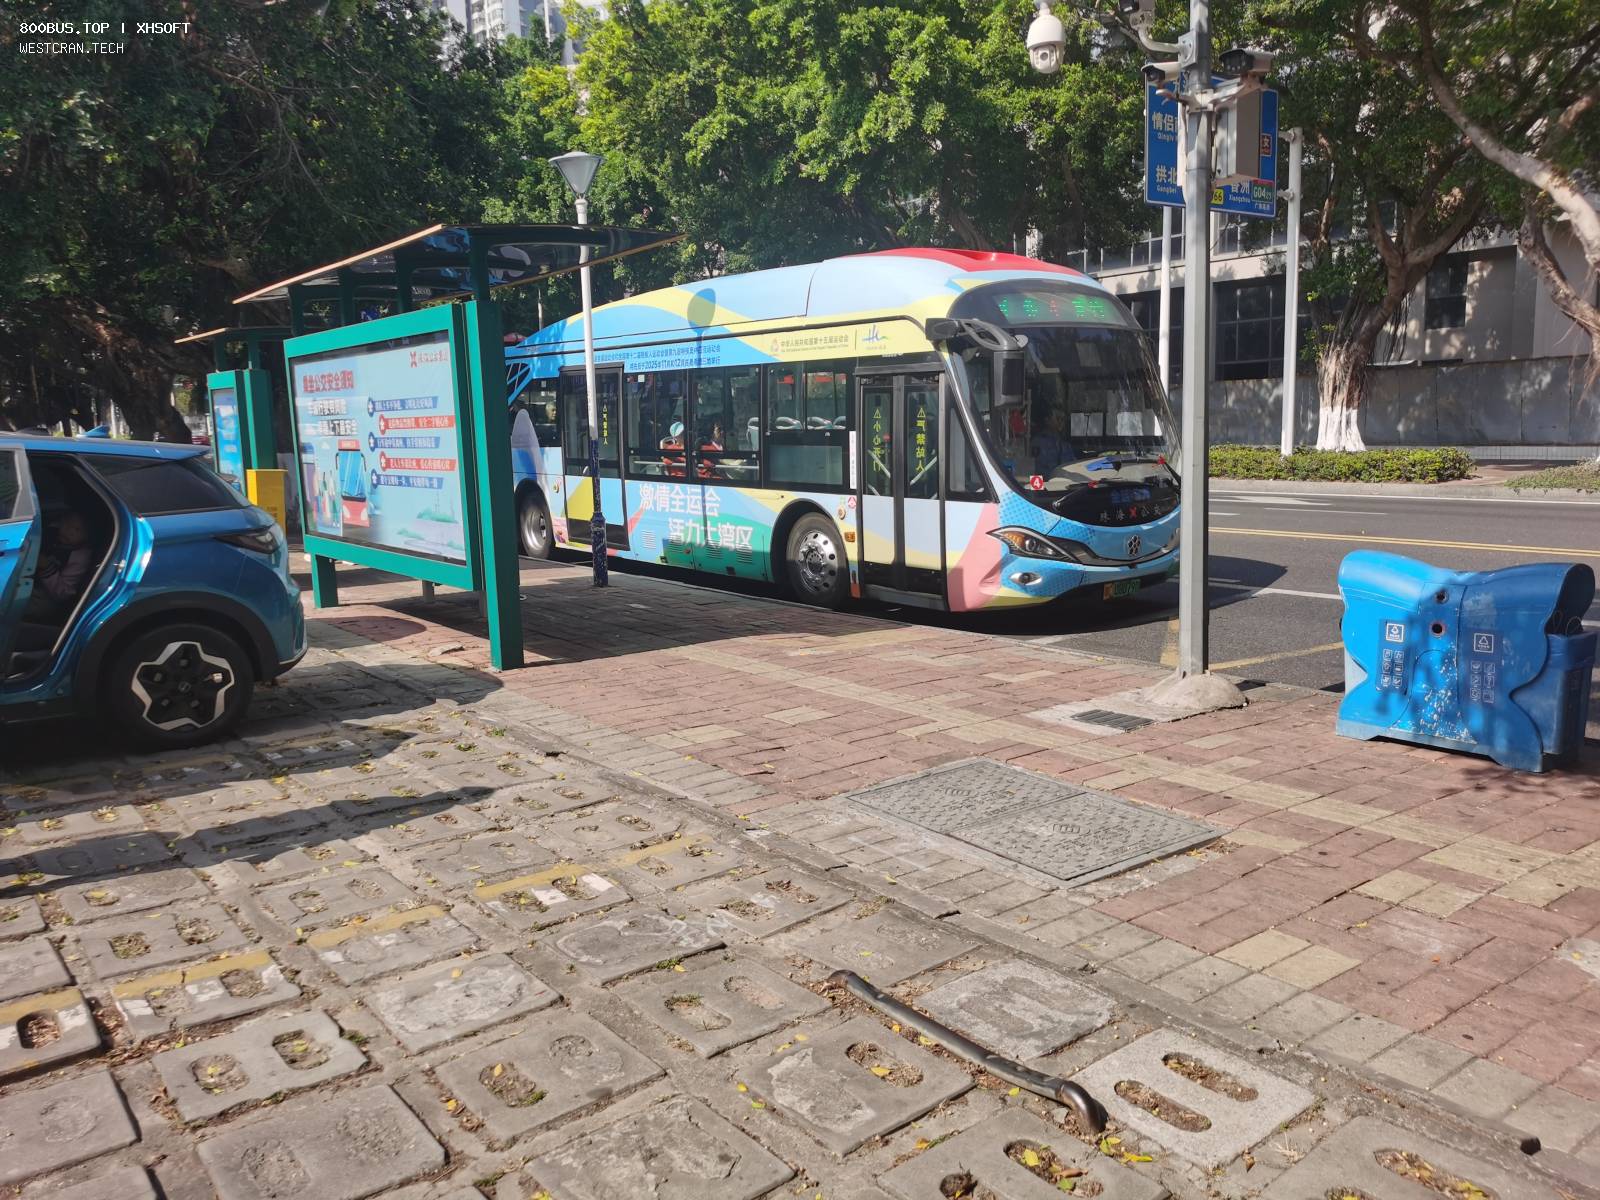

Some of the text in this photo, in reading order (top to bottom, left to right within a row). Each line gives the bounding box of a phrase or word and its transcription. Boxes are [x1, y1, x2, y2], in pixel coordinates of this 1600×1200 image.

[639, 483, 721, 517] 激情全运会
[668, 517, 754, 551] 活力大湾区
